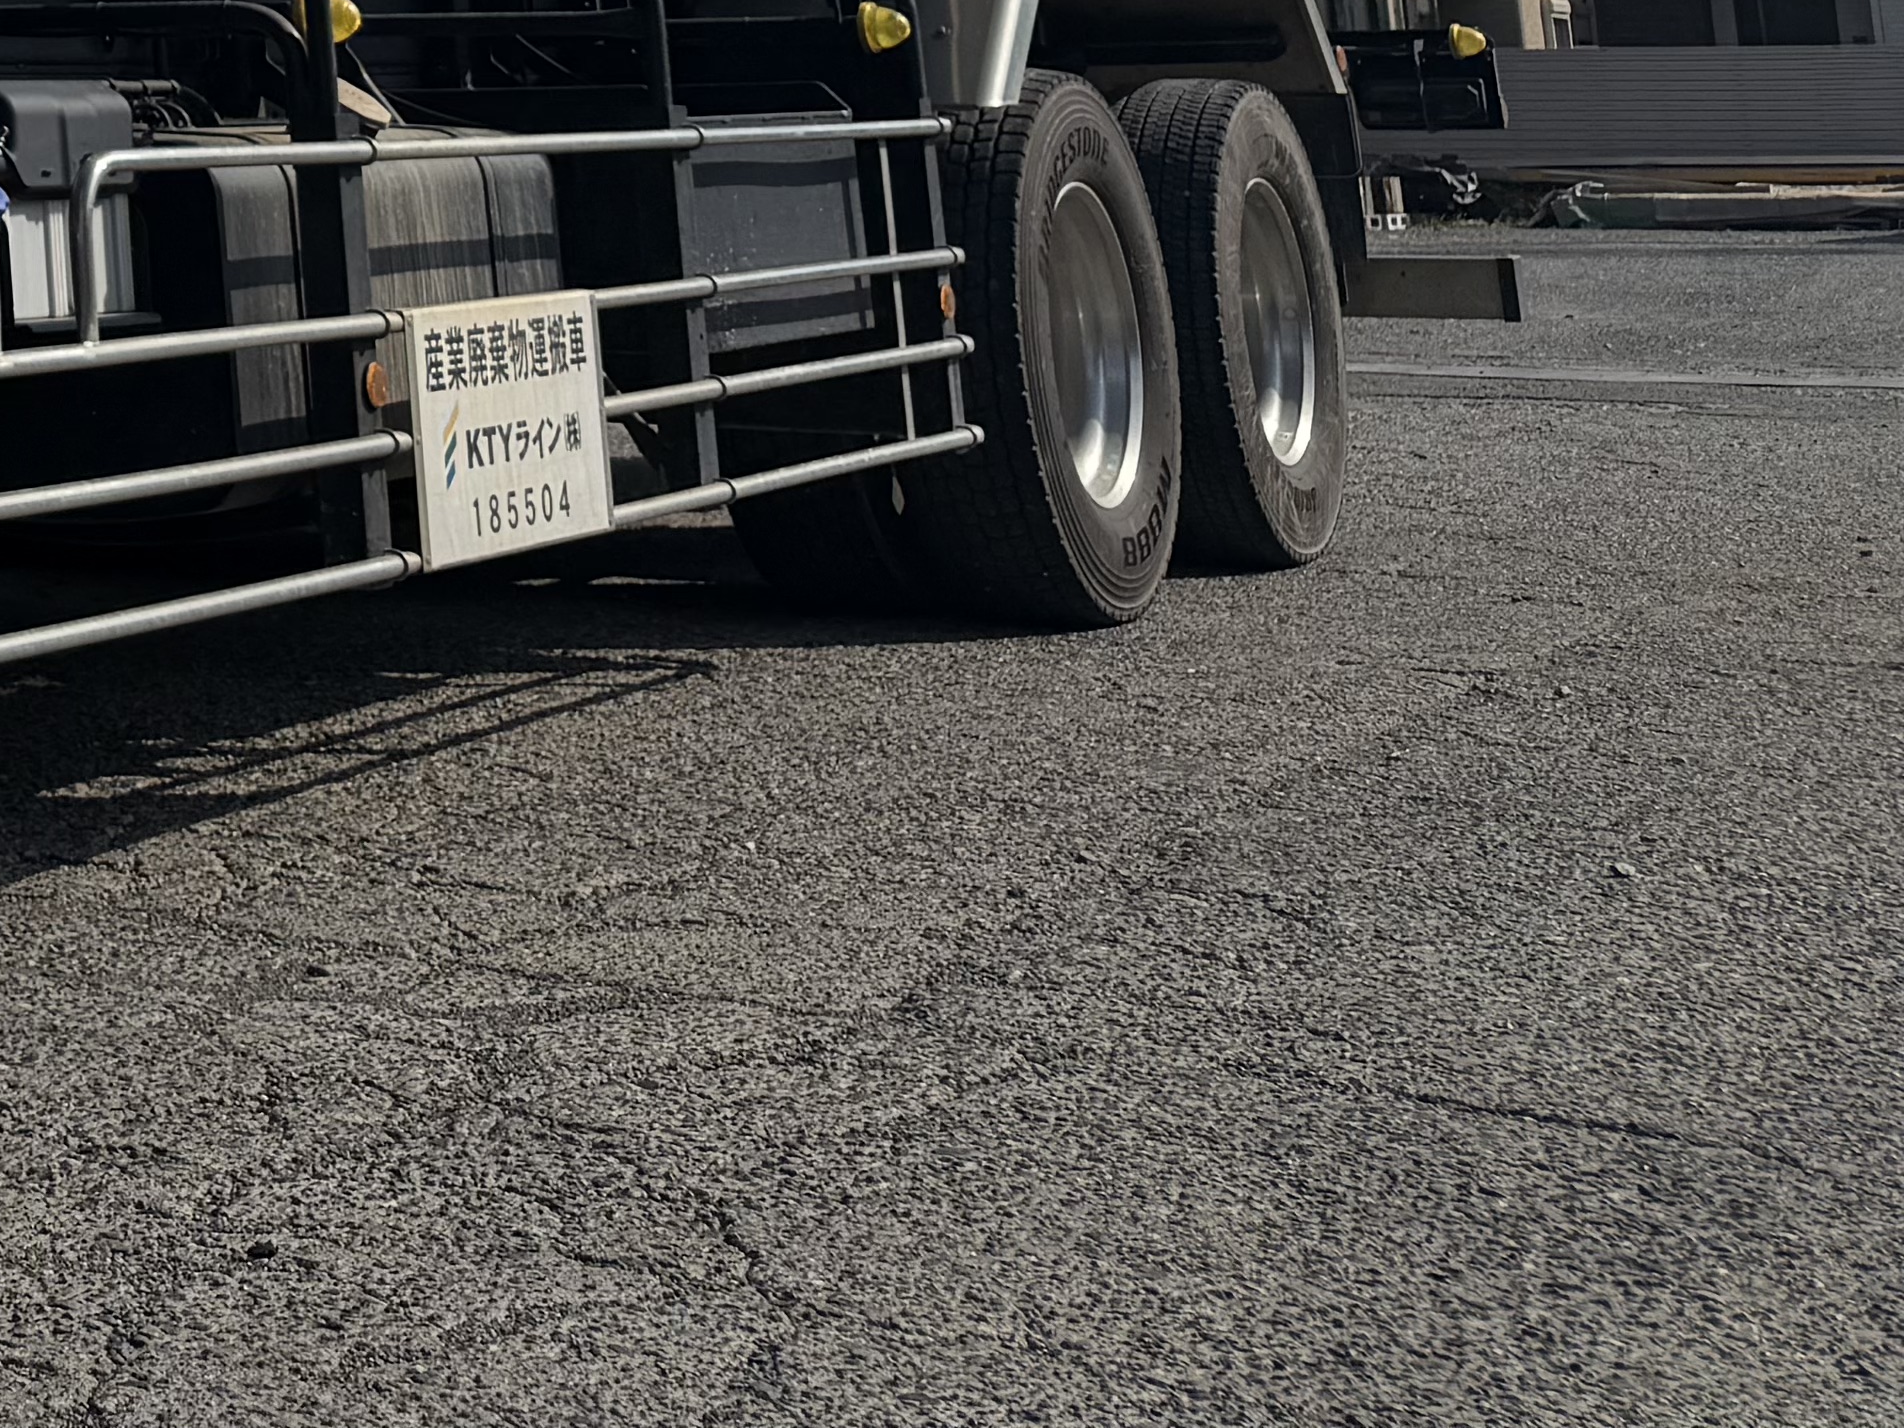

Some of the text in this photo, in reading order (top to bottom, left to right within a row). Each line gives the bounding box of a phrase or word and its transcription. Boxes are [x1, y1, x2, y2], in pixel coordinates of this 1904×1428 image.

[423, 310, 588, 393] 産業廃棄物運搬車
[472, 480, 571, 537] 185504
